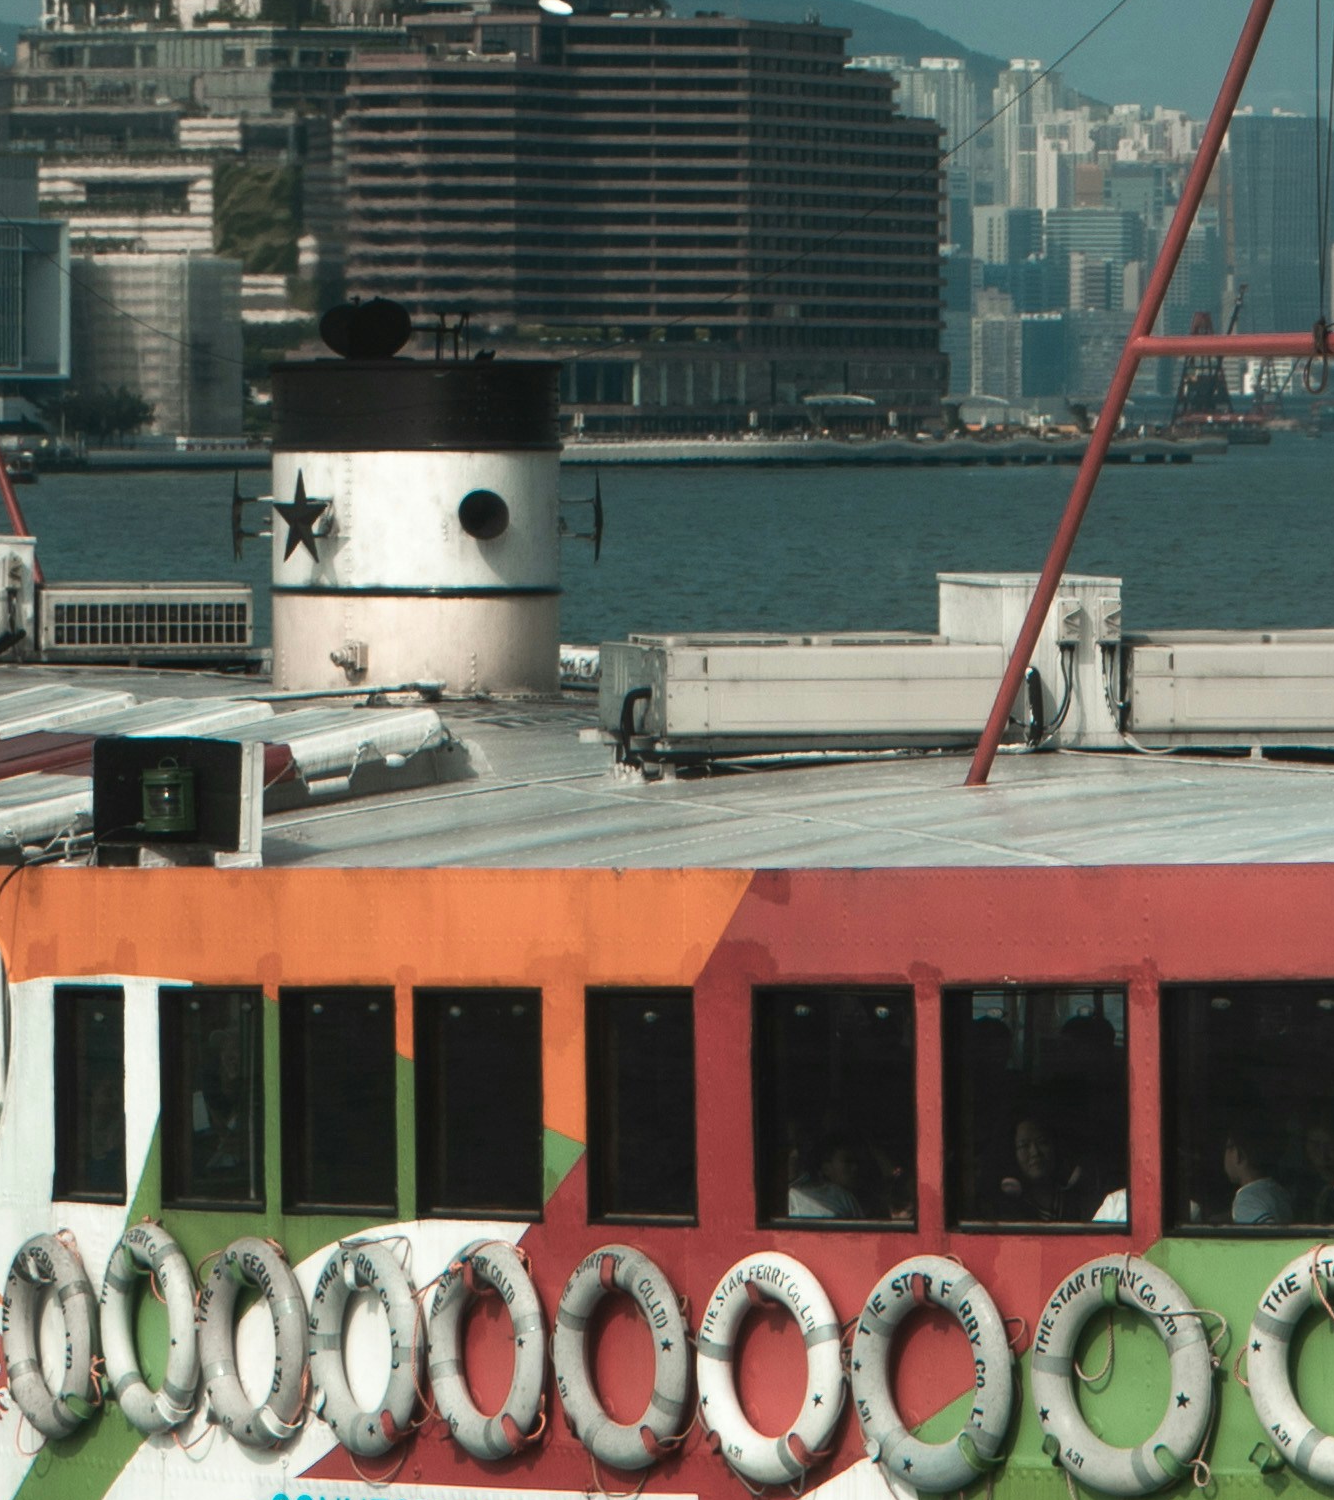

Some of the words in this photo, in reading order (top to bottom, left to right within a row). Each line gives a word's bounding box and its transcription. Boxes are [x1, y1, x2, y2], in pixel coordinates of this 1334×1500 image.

[315, 1261, 341, 1304] STAR
[341, 1251, 379, 1284] FRRY
[715, 1268, 745, 1307] STAR
[747, 1263, 789, 1289] FERRY
[1262, 1272, 1302, 1314] THE
[651, 1300, 669, 1330] LTD
[939, 1280, 982, 1348] FRRY
[1035, 1313, 1055, 1355] THE
[1050, 1272, 1087, 1315] STAR
